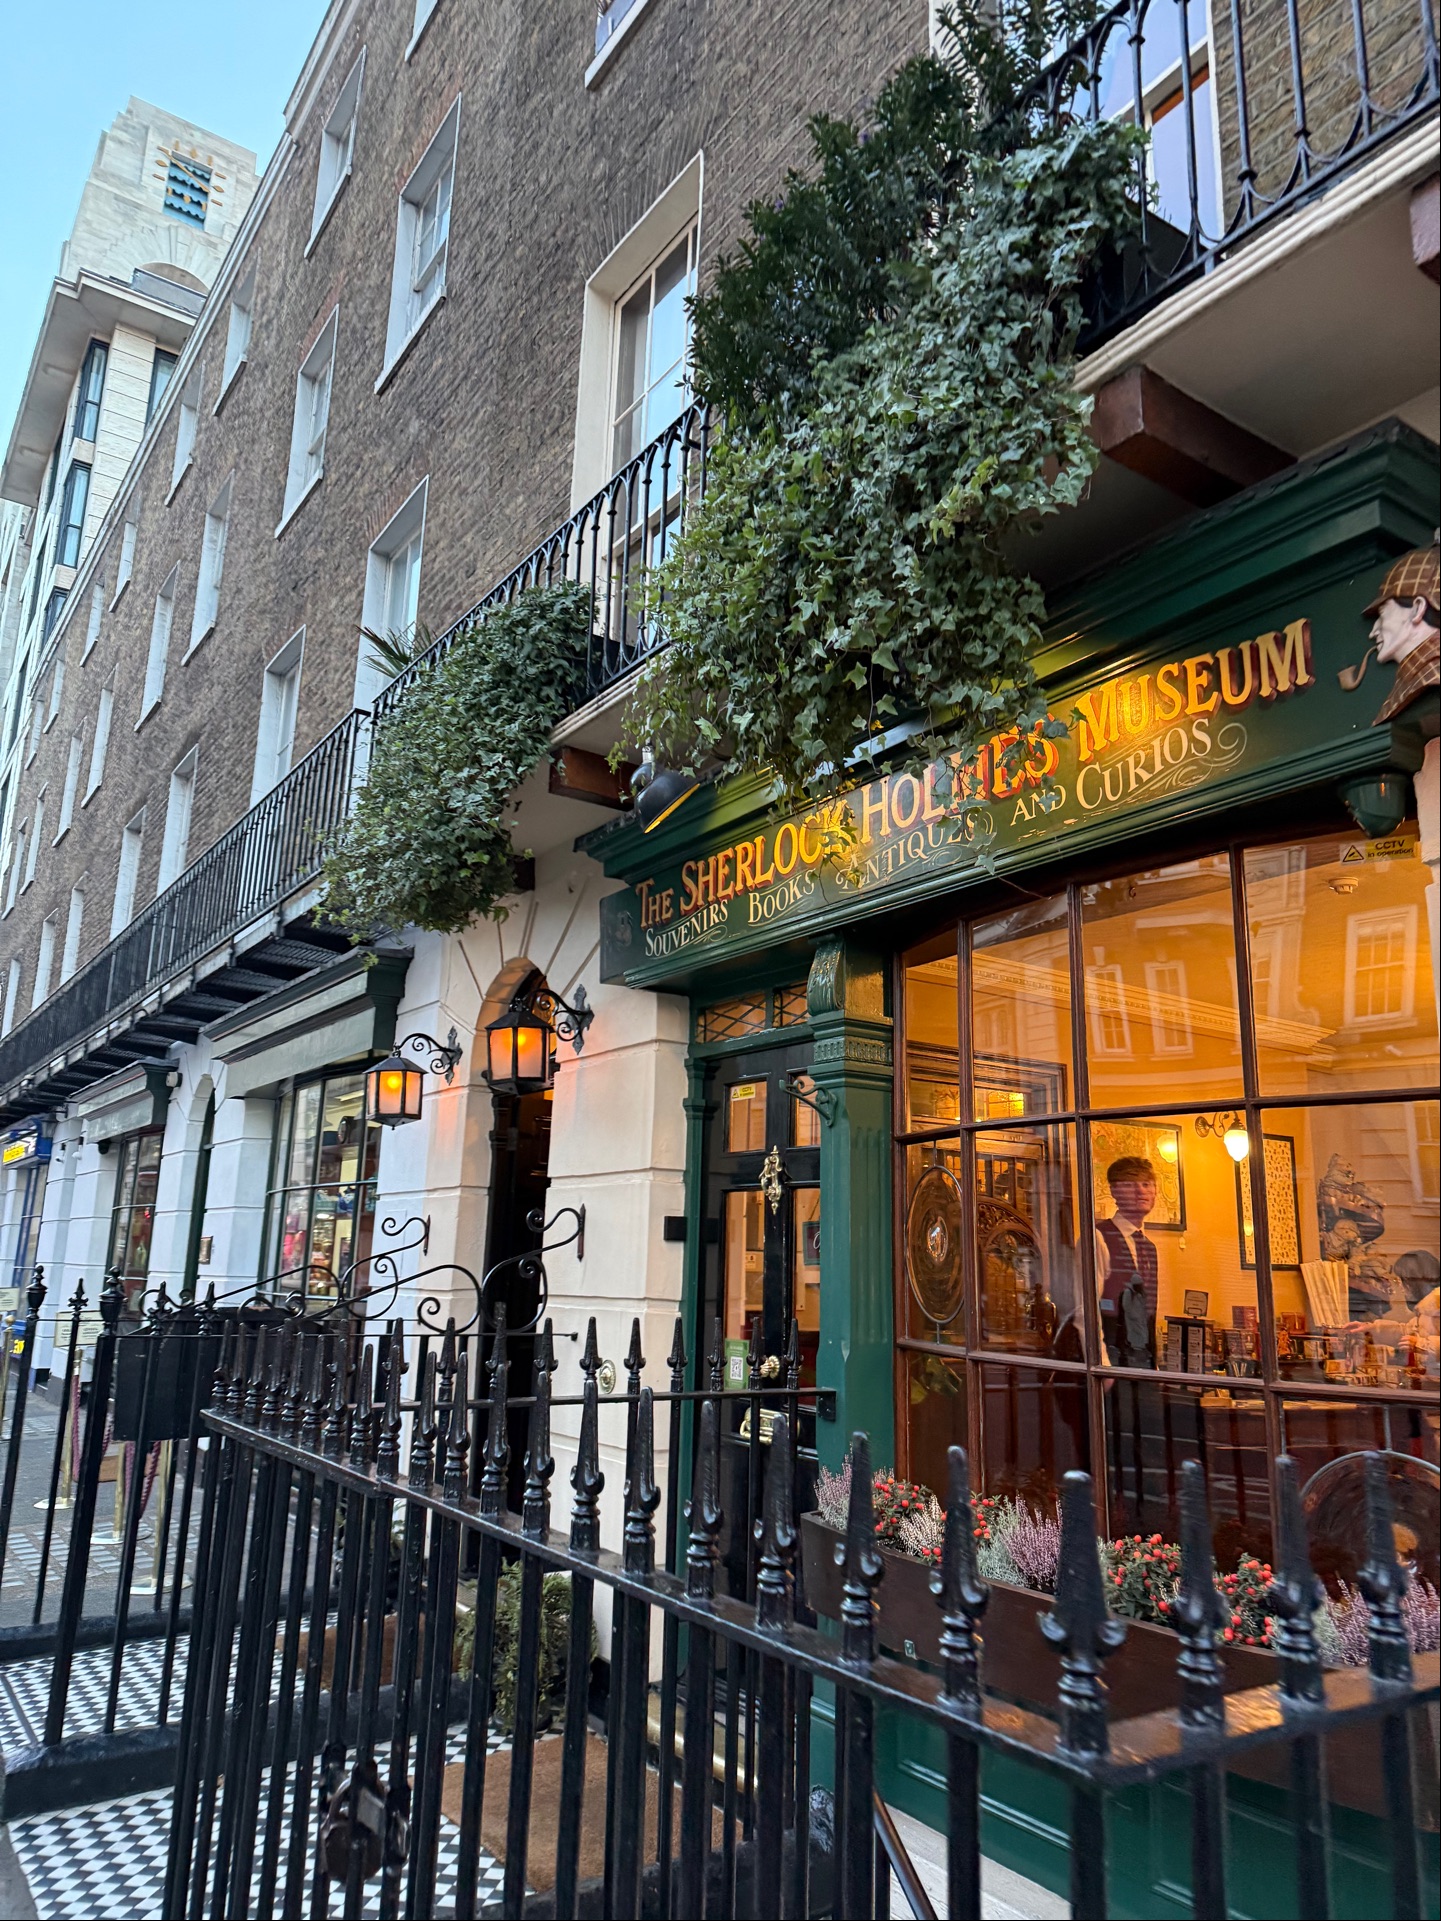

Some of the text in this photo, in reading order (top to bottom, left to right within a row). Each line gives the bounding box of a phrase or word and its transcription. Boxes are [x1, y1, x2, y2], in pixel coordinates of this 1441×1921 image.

[635, 878, 675, 930] THE
[680, 800, 855, 913] SHERLOCK
[1075, 618, 1315, 762] MUSEUM
[645, 899, 728, 957] SOUVENIRS
[748, 868, 815, 923] BOOKS
[1010, 784, 1066, 826] AND
[1076, 718, 1212, 810] CURIOS
[1375, 840, 1405, 850] CCTV
[1377, 847, 1414, 857] operation
